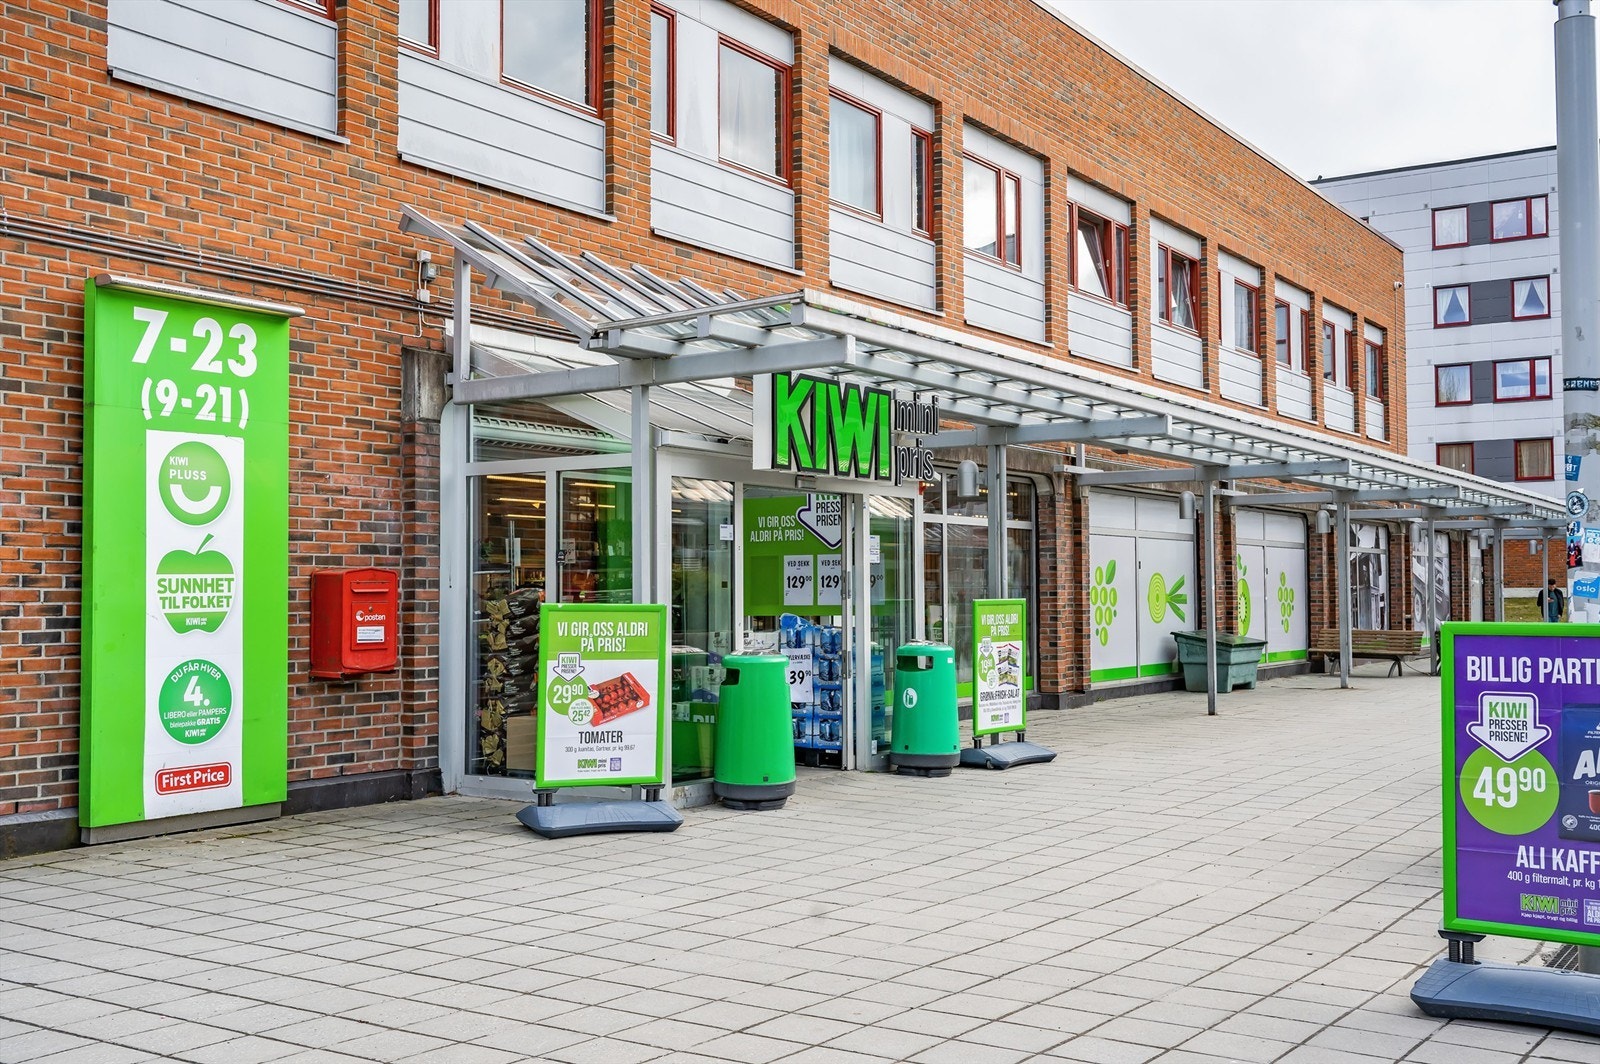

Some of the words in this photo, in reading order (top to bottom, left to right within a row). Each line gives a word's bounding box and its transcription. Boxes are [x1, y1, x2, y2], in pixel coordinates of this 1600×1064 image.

[132, 306, 257, 377] 7-23
[142, 377, 248, 430] (9-21)
[894, 392, 939, 435] mini
[772, 372, 891, 480] KIWI
[170, 456, 188, 466] KIWI
[894, 438, 934, 487] pris
[170, 469, 207, 480] PLUSS
[758, 517, 765, 528] VI
[767, 516, 779, 527] GIR
[781, 515, 795, 526] OSS
[750, 531, 771, 542] ALDRI
[773, 527, 783, 541] PÅ
[785, 529, 804, 541] PRIS!
[157, 578, 234, 594] SUNNHET
[1576, 585, 1596, 593] oslo
[160, 596, 180, 609] TIL
[182, 595, 232, 608] FOLKET
[364, 614, 385, 622] posten
[557, 622, 568, 637] VI
[571, 622, 588, 637] GIR
[592, 622, 614, 636] OSS
[616, 622, 648, 636] ALDRI
[581, 633, 594, 652] PÅ
[597, 637, 626, 652] PRIS!
[561, 656, 577, 664] KIWI
[171, 669, 183, 683] DU
[183, 662, 199, 674] FÅR
[200, 663, 221, 680] HVER
[1467, 656, 1531, 683] BILLIG
[184, 675, 210, 706] 4.
[164, 711, 186, 719] LIBERO
[198, 708, 227, 716] PAMPERS
[1488, 702, 1527, 719] KIWI
[197, 717, 221, 726] GRATIS
[1489, 719, 1528, 731] PRESSER
[185, 729, 200, 737] KIWI
[578, 731, 623, 744] TOMATER
[1489, 730, 1528, 743] PRISENE!
[578, 758, 597, 769] KIWI
[162, 772, 190, 788] First
[193, 770, 225, 786] Price
[1516, 845, 1544, 870] ALI
[1552, 848, 1600, 874] KAFF
[1507, 870, 1522, 881] 400
[1525, 874, 1530, 884] g
[1532, 873, 1571, 887] filtermalt,
[1573, 879, 1583, 888] pr.
[1585, 878, 1595, 890] kg
[1520, 893, 1559, 914] KIWI
[1560, 898, 1578, 908] mini
[1560, 907, 1577, 916] pris
